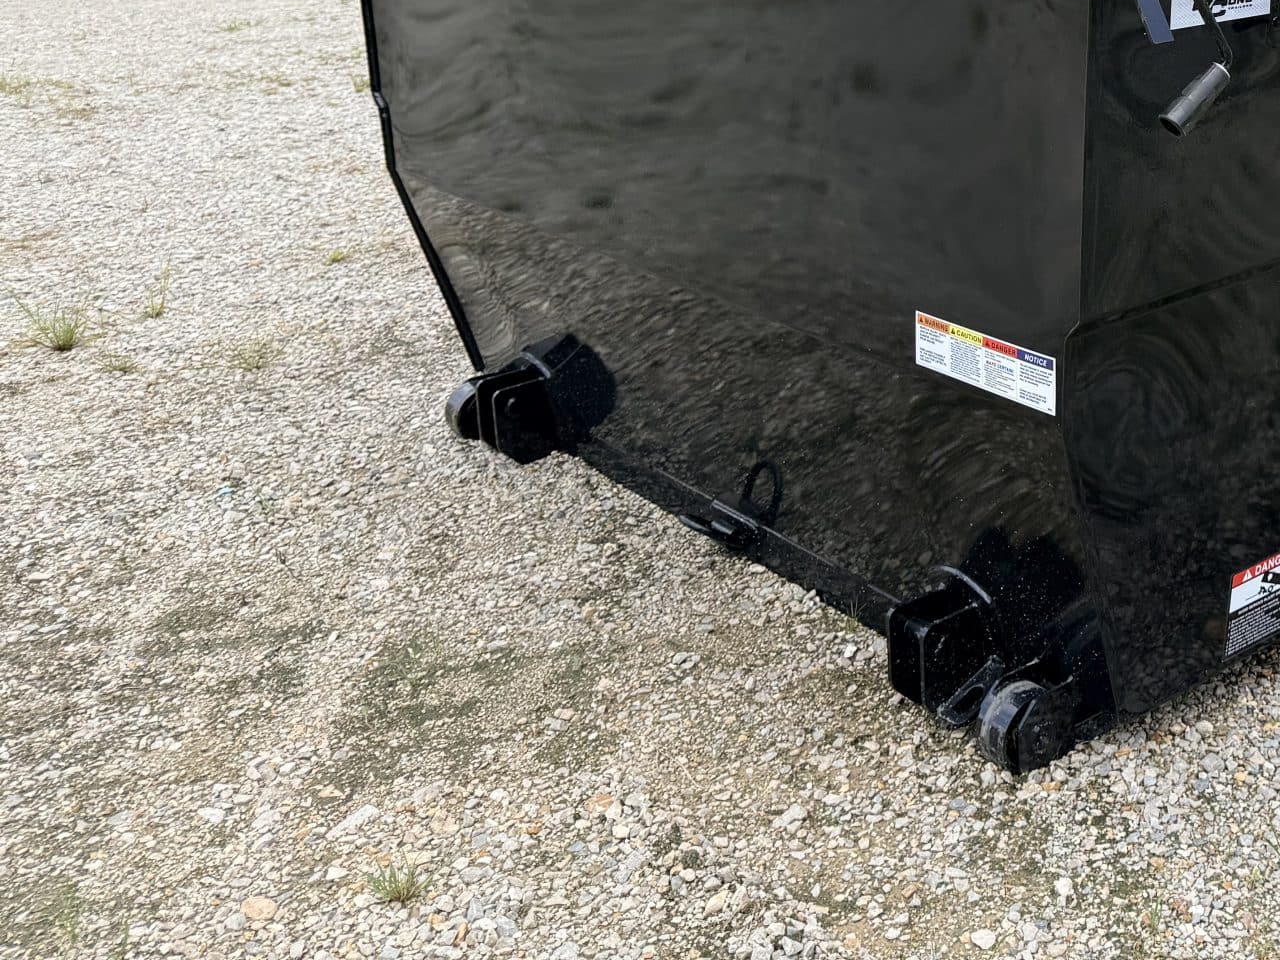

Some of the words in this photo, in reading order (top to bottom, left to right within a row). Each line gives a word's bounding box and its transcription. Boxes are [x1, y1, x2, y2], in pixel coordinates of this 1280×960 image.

[924, 318, 949, 332] WARNING
[956, 329, 982, 343] CAUTION
[991, 342, 1016, 356] DANGER
[1024, 353, 1048, 367] NOTICE
